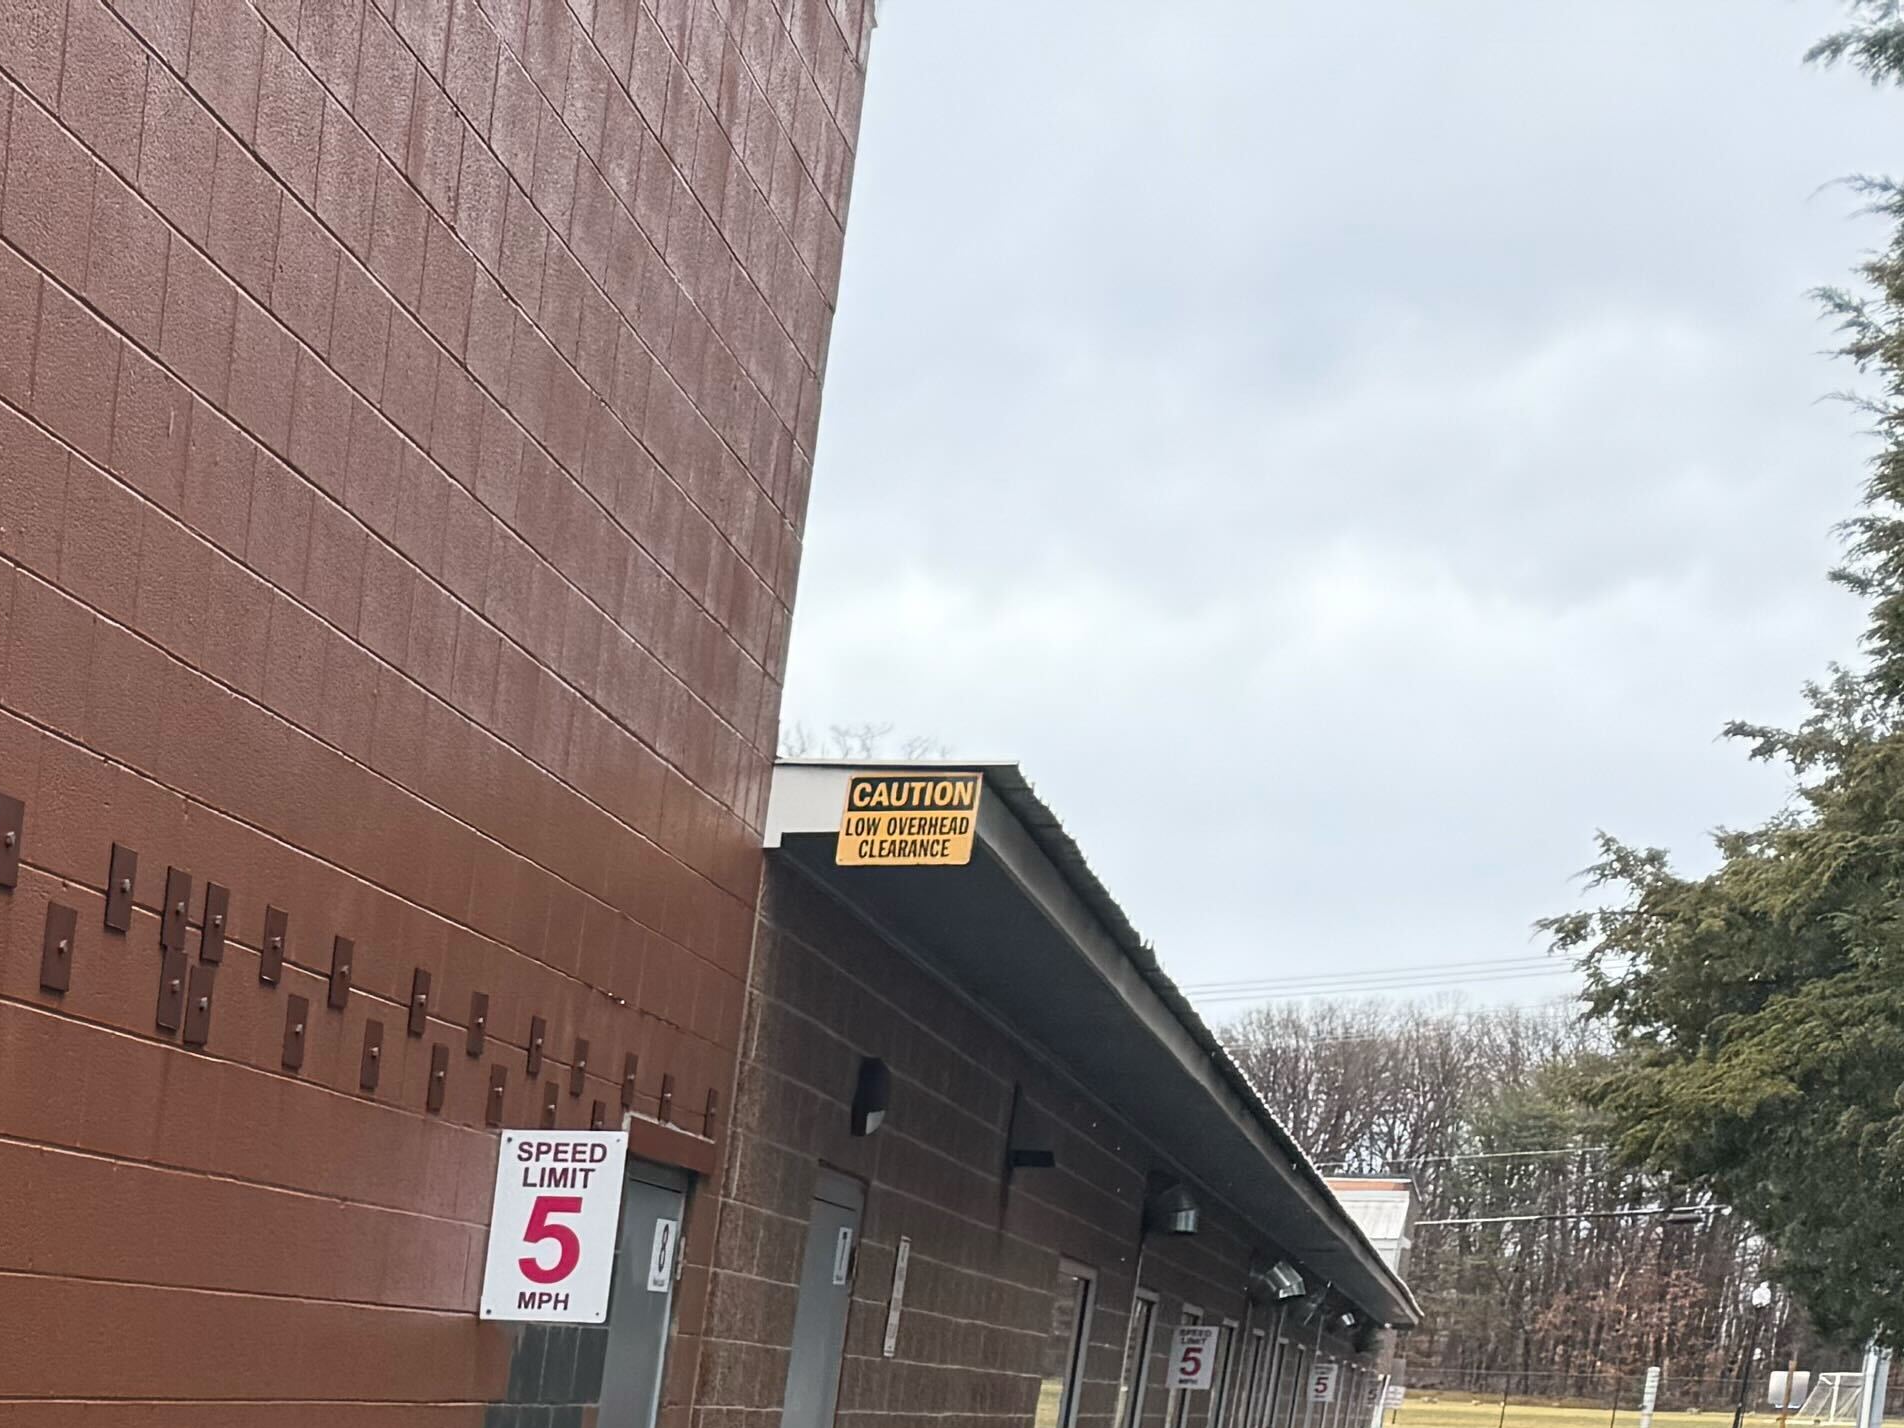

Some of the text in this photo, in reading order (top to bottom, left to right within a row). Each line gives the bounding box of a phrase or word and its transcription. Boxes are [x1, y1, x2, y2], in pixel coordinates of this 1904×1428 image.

[852, 781, 975, 808] CAUTION
[844, 815, 970, 837] LOW OVERHEAD
[858, 838, 952, 859] CLEARANCE
[517, 1141, 608, 1164] SPEED
[522, 1167, 596, 1189] LIMIT
[518, 1195, 583, 1285] 5
[657, 1223, 670, 1273] 8
[517, 1291, 570, 1311] MPH
[1179, 1346, 1204, 1377] 5
[1314, 1376, 1329, 1394] 5
